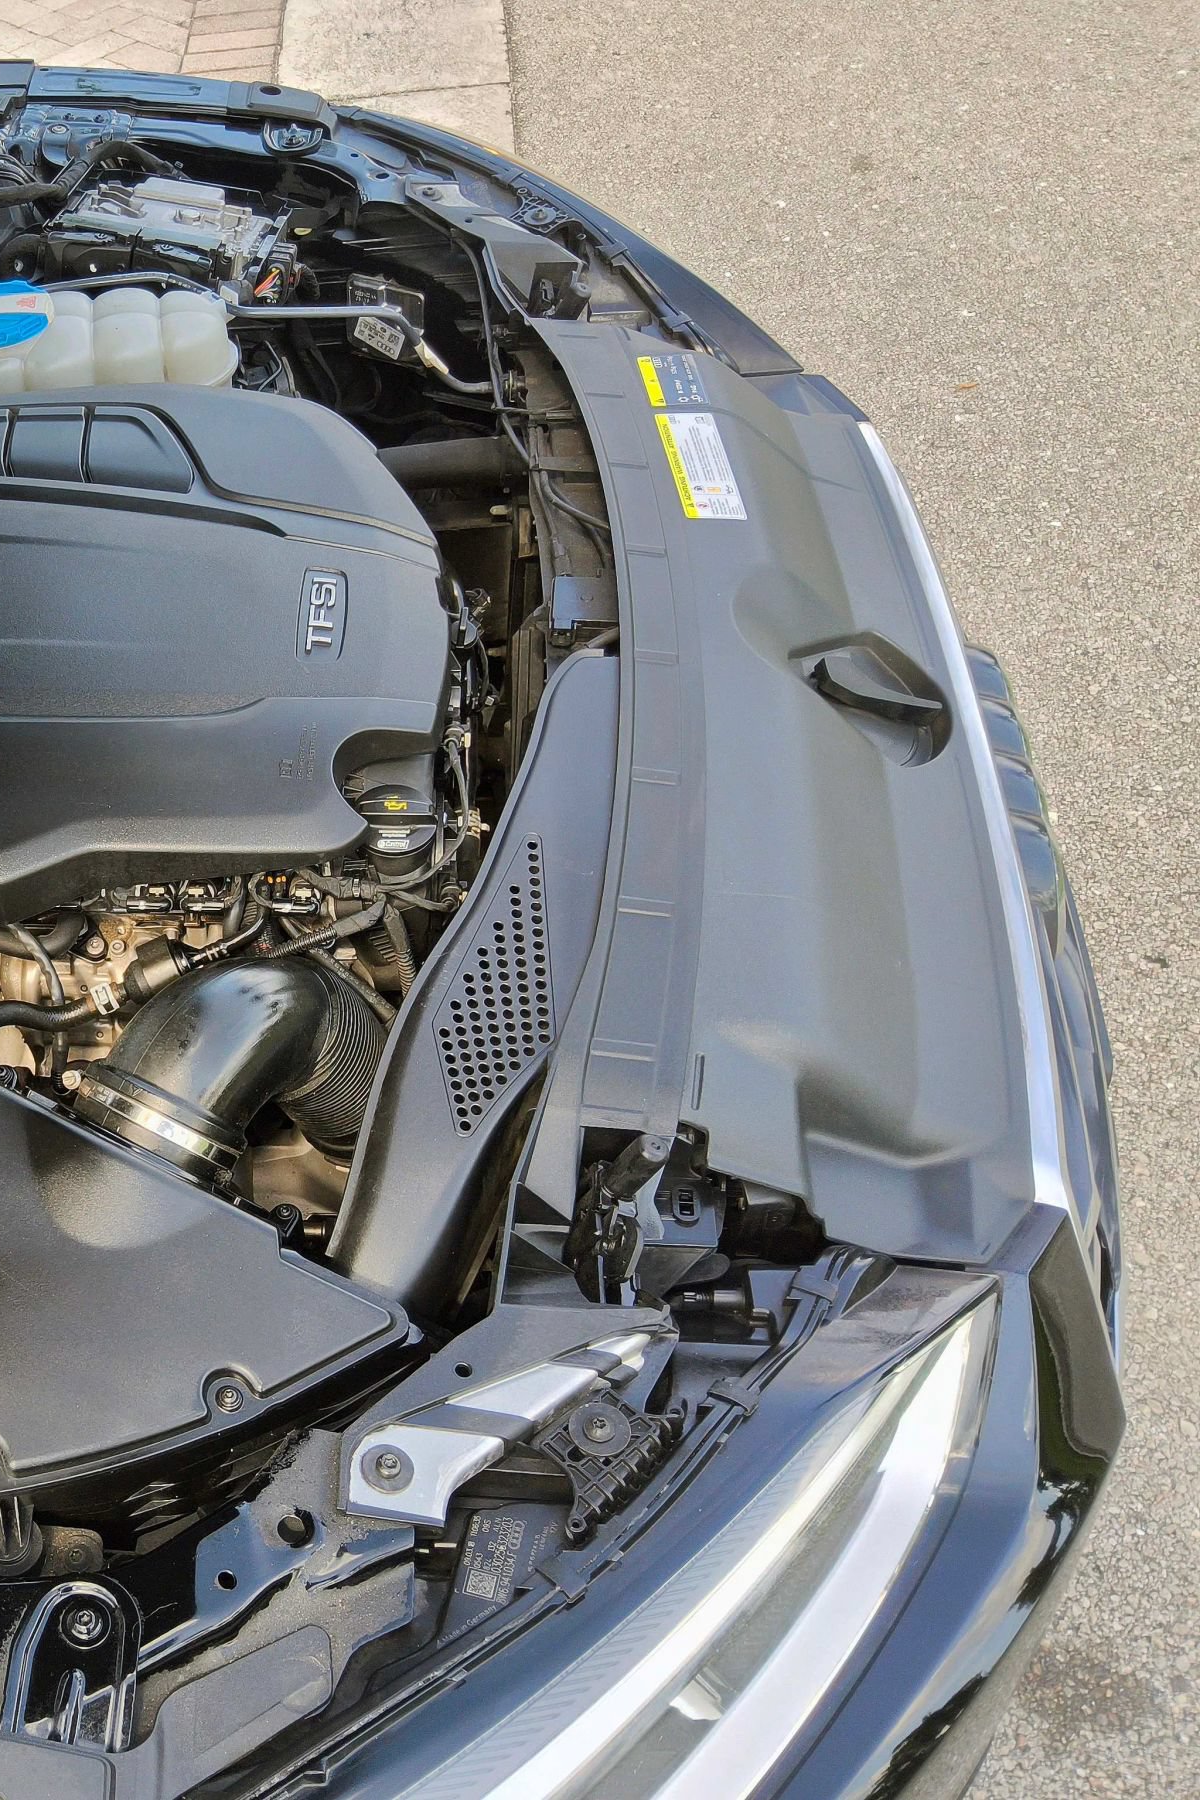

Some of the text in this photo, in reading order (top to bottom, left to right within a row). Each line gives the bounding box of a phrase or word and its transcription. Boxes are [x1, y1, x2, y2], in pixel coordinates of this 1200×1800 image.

[662, 423, 674, 449] ATTENTION
[670, 450, 683, 475] WARNING
[679, 476, 691, 501] ACHTUNG
[305, 577, 337, 651] TFSI
[466, 1604, 497, 1626] Germany
